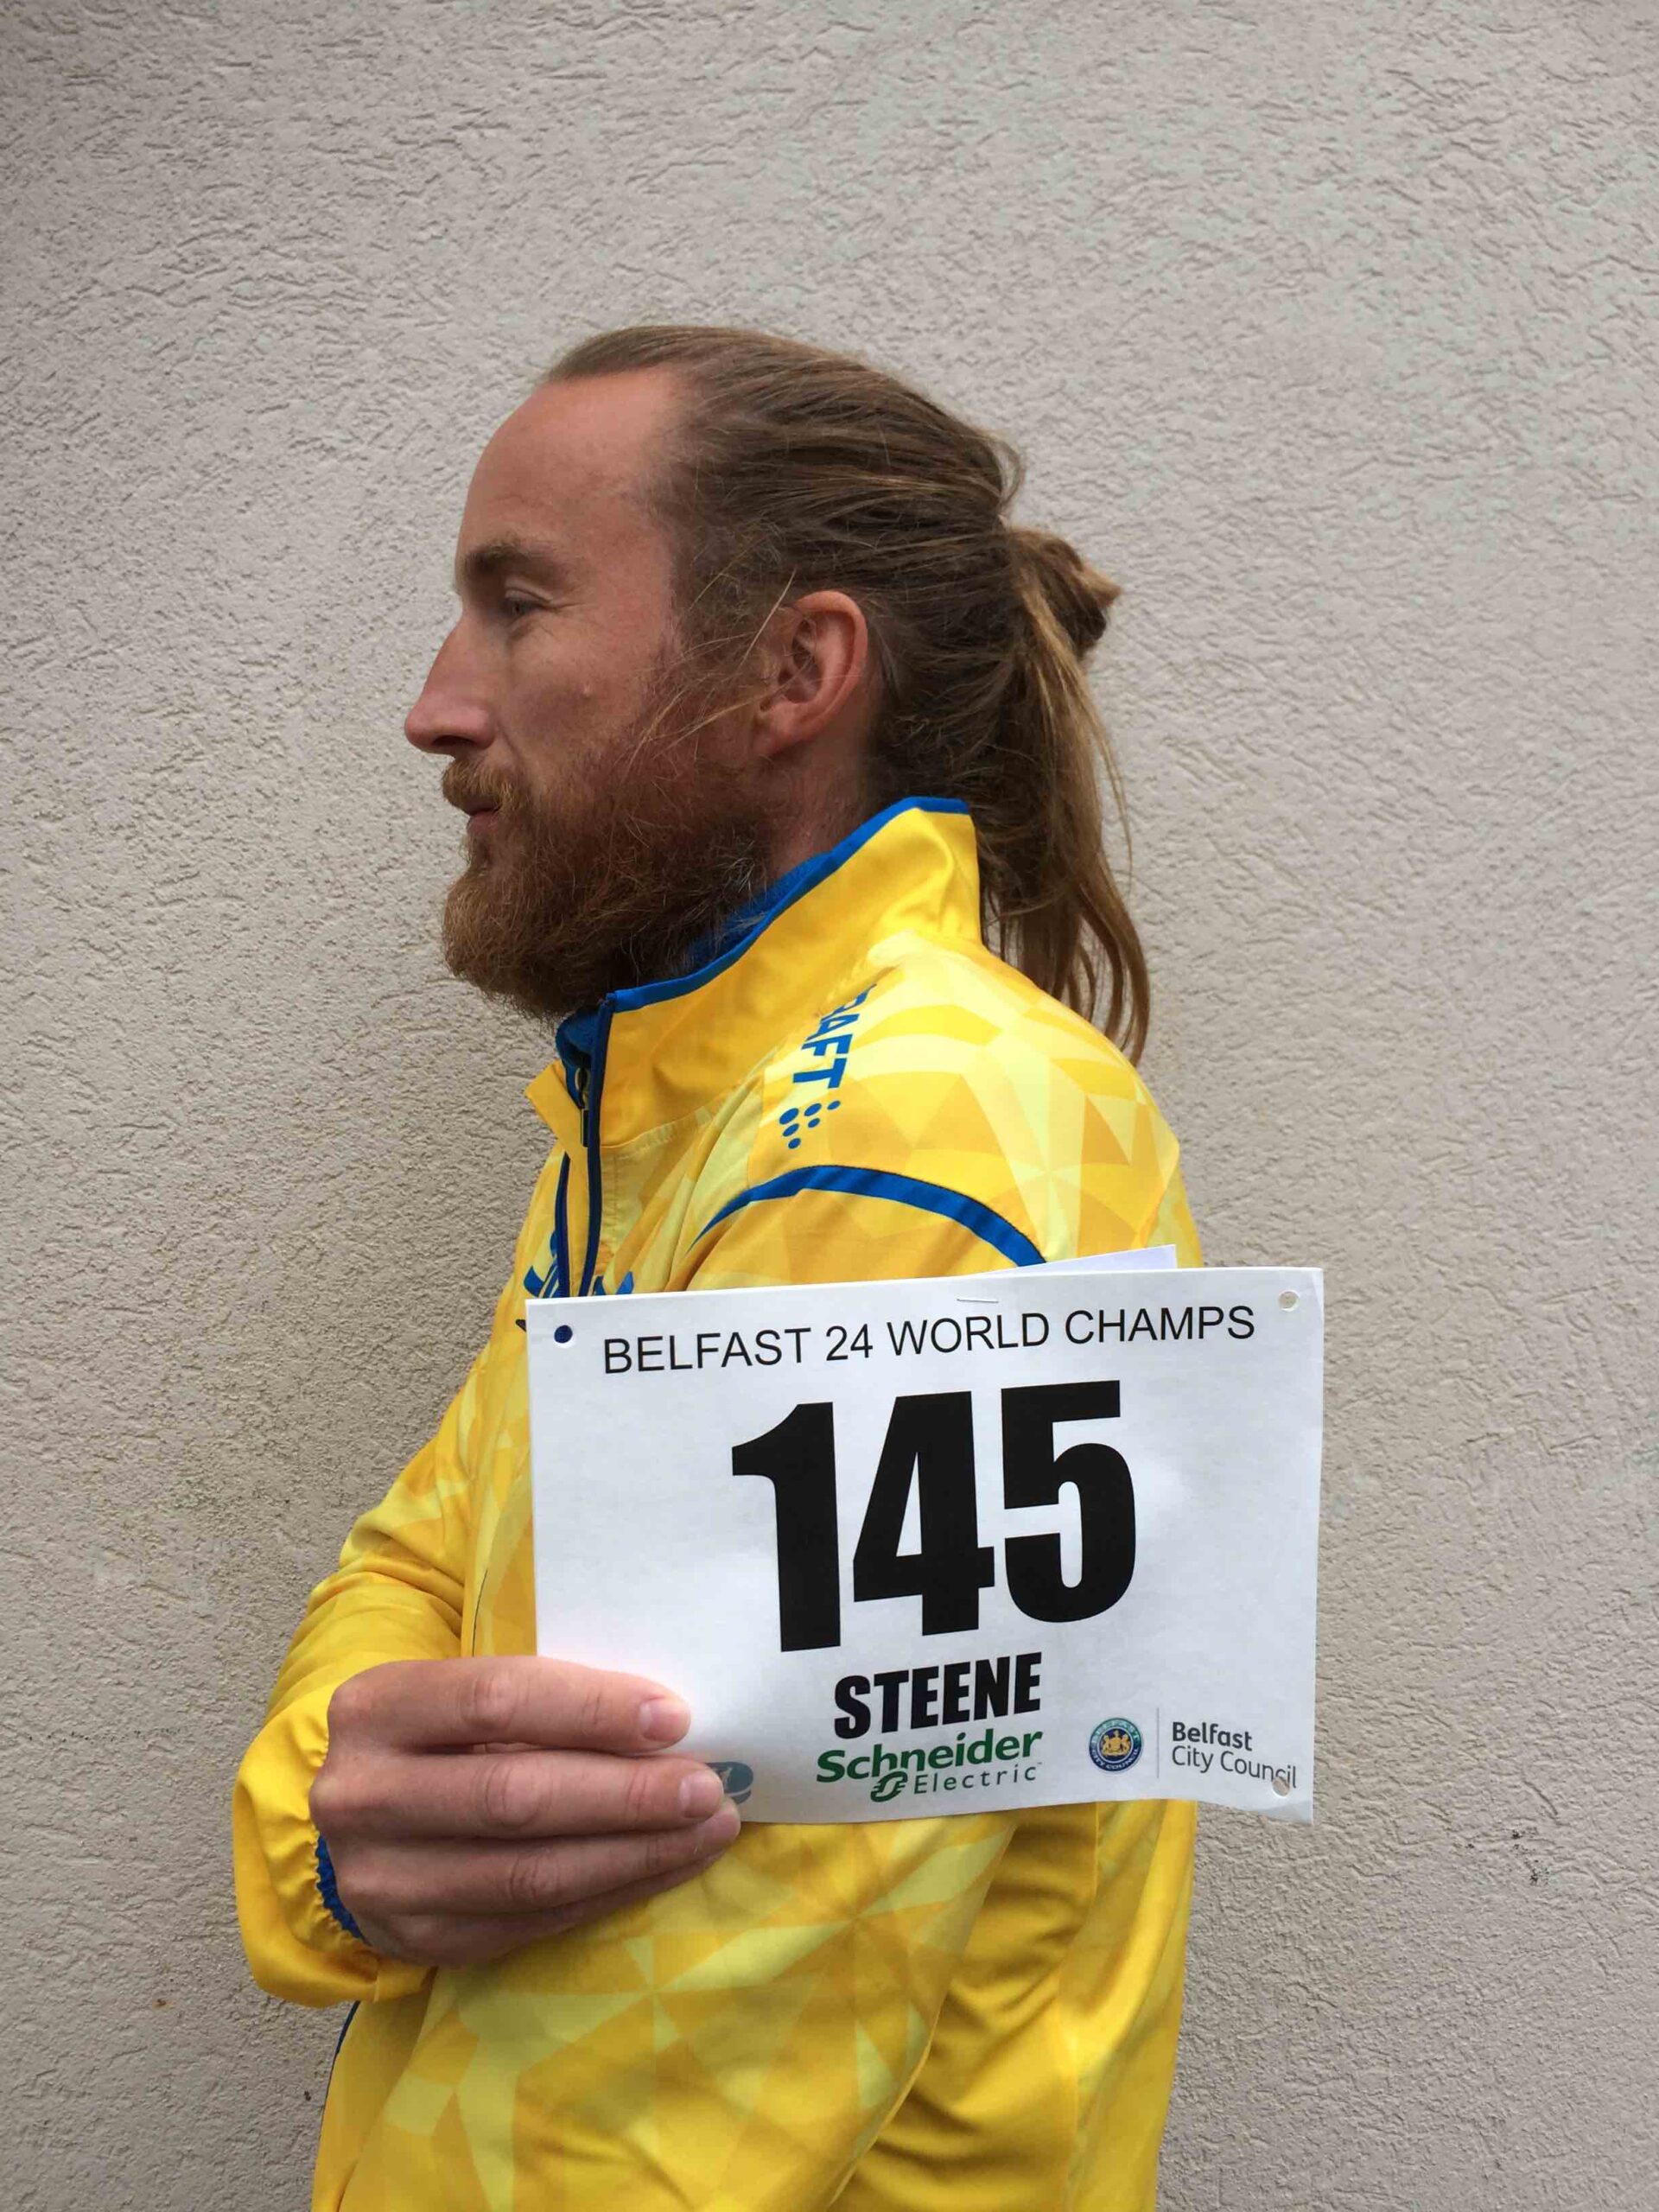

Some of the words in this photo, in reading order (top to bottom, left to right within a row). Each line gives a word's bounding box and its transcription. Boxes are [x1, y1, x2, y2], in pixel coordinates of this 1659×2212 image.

[605, 1327, 811, 1374] BELFAST
[825, 1324, 873, 1361] 24
[887, 1313, 1050, 1356] WORLD
[1065, 1306, 1255, 1344] CHAMPS
[732, 1380, 1136, 1651] 145
[834, 1651, 1042, 1739] STEENE
[817, 1728, 1044, 1783] Schneider
[1172, 1721, 1253, 1751] Belfast
[913, 1764, 1037, 1794] Electric
[1172, 1745, 1214, 1773] City
[1220, 1751, 1297, 1789] Council
